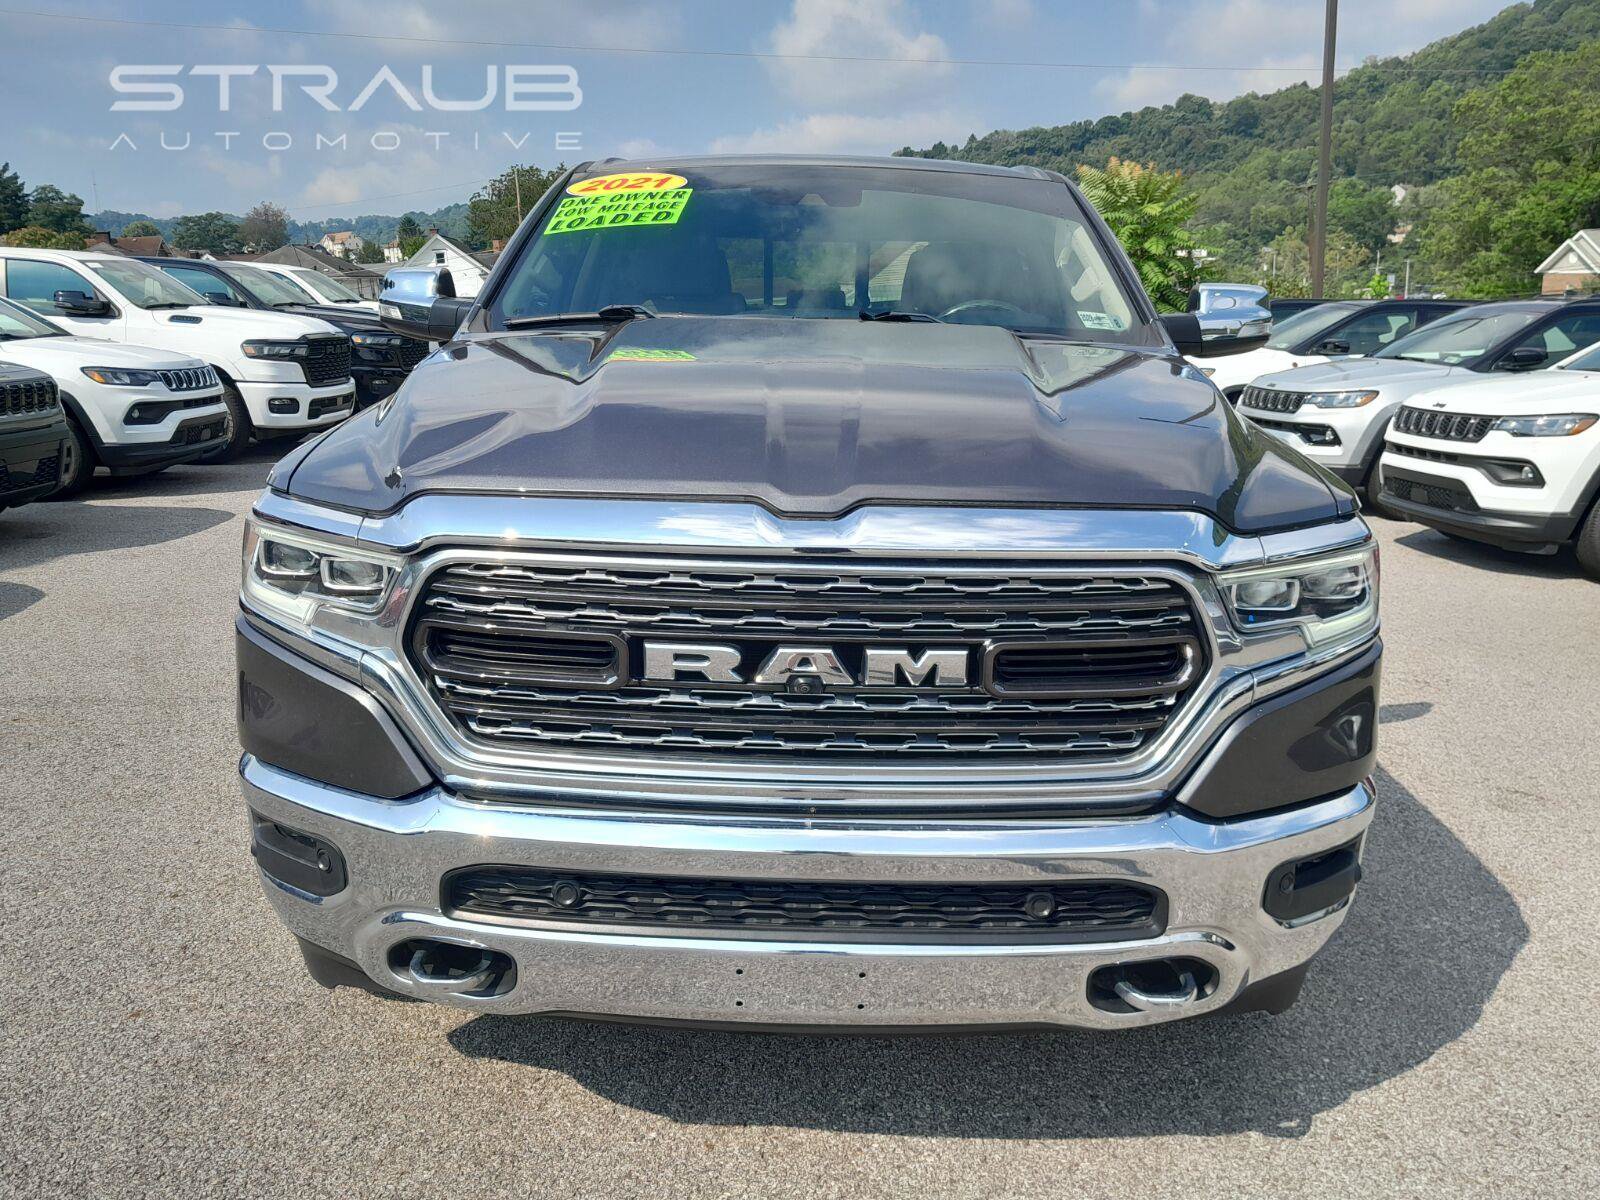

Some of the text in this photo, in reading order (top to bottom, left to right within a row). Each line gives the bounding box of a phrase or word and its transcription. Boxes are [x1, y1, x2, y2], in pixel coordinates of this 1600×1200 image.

[580, 177, 672, 192] 2021
[561, 190, 688, 208] ONE OWNER
[554, 200, 682, 218] LOW MILEAGE
[550, 210, 673, 231] LOADED
[643, 640, 969, 686] RAM
